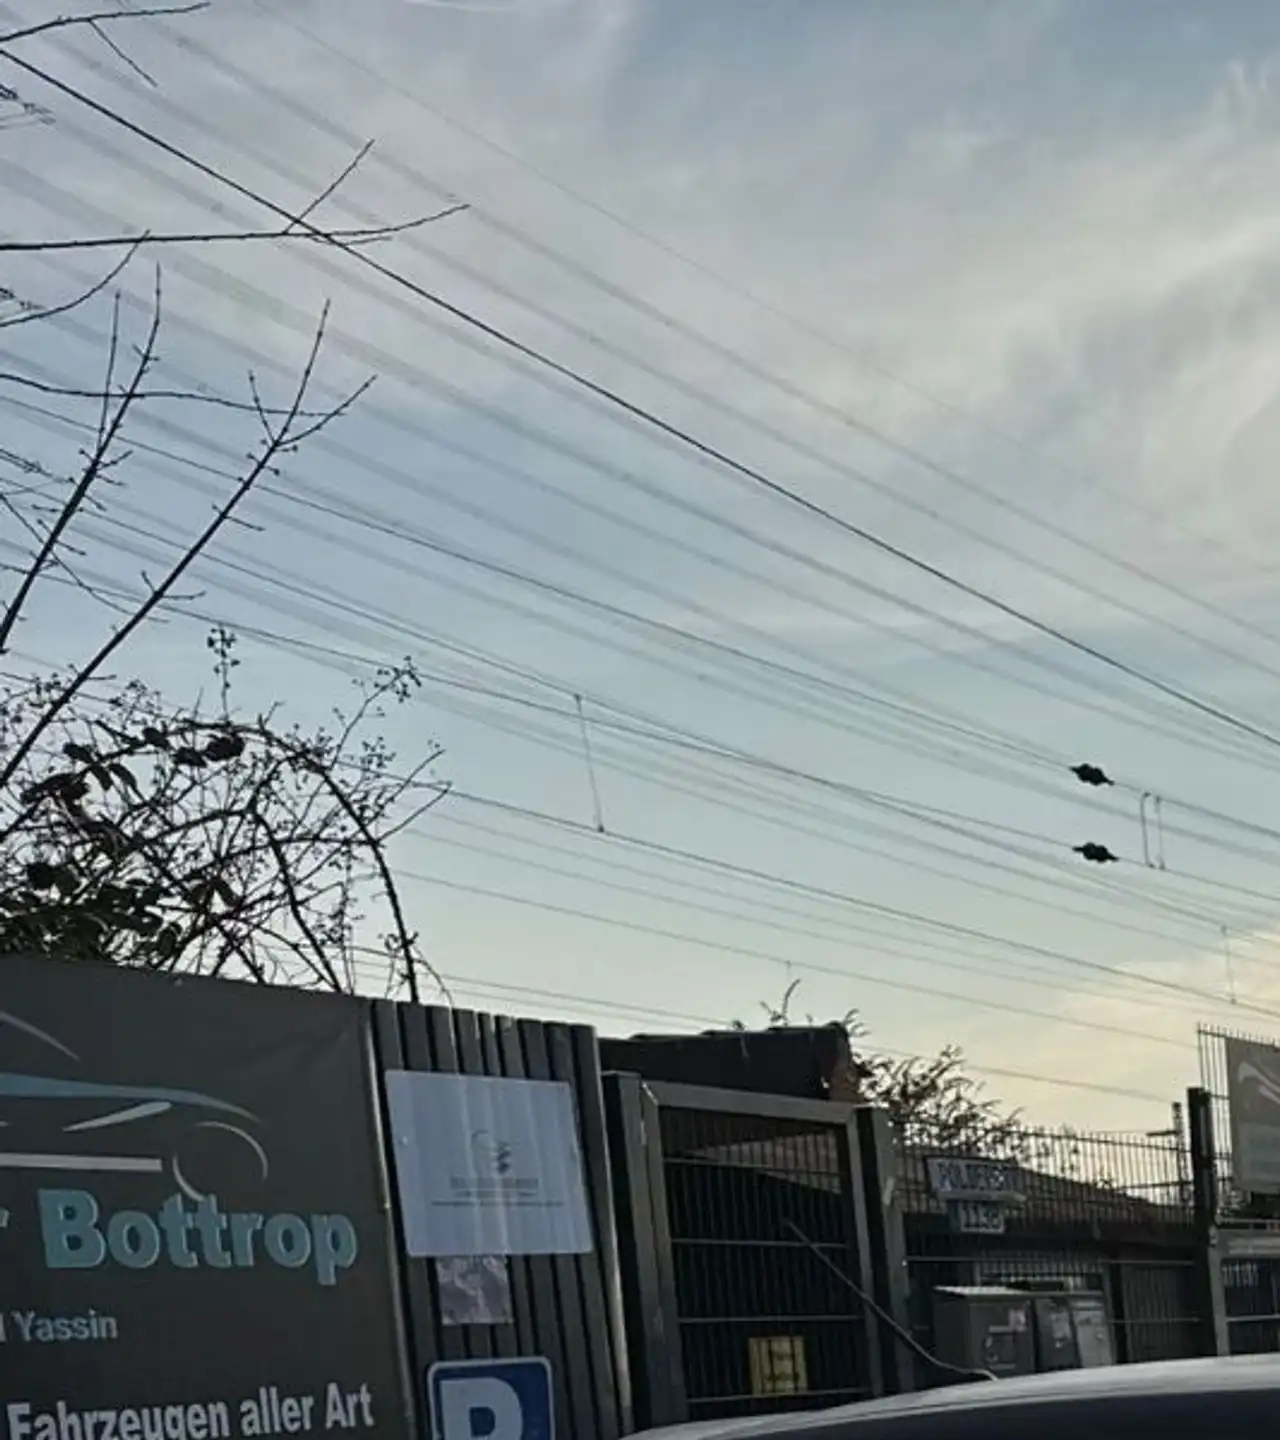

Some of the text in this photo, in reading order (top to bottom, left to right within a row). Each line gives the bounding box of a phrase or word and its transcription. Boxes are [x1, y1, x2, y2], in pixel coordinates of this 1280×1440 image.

[38, 1188, 357, 1285] Bottrop
[10, 1308, 118, 1342] Yassin
[240, 1386, 314, 1437] aller
[324, 1382, 374, 1430] Art
